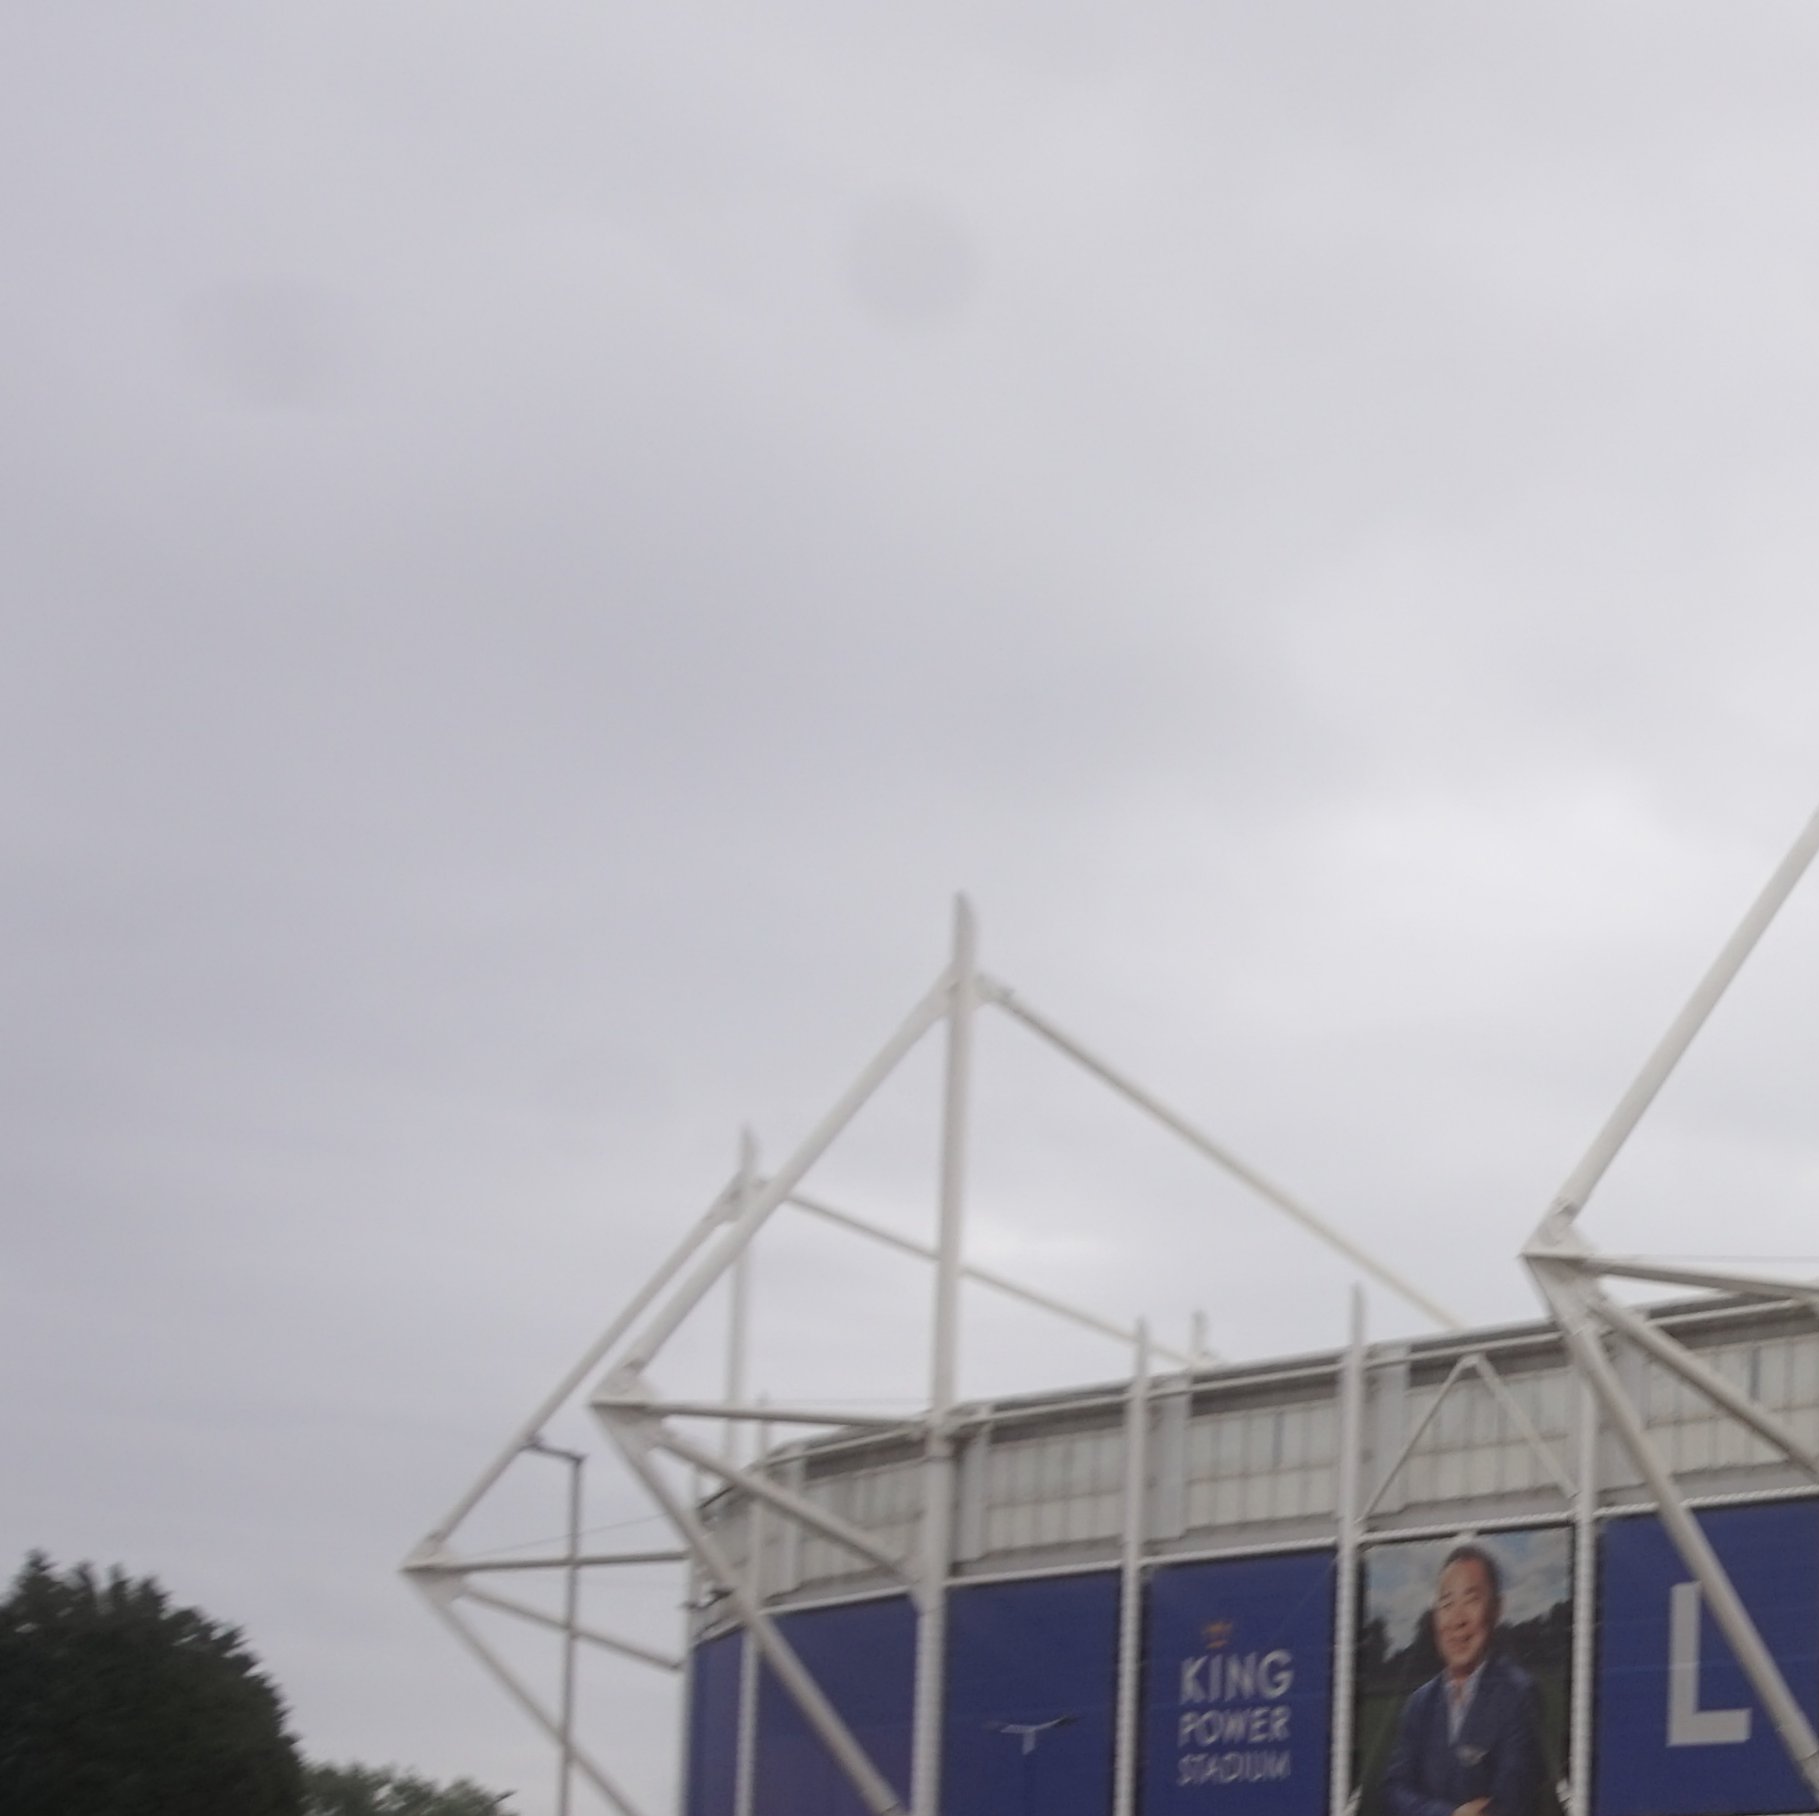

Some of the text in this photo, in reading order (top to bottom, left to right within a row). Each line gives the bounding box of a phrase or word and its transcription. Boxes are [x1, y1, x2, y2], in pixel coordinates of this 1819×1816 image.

[1179, 1650, 1295, 1705] KING
[1667, 1580, 1752, 1747] L
[1177, 1704, 1292, 1748] POWER
[1176, 1750, 1291, 1787] STADIUM
